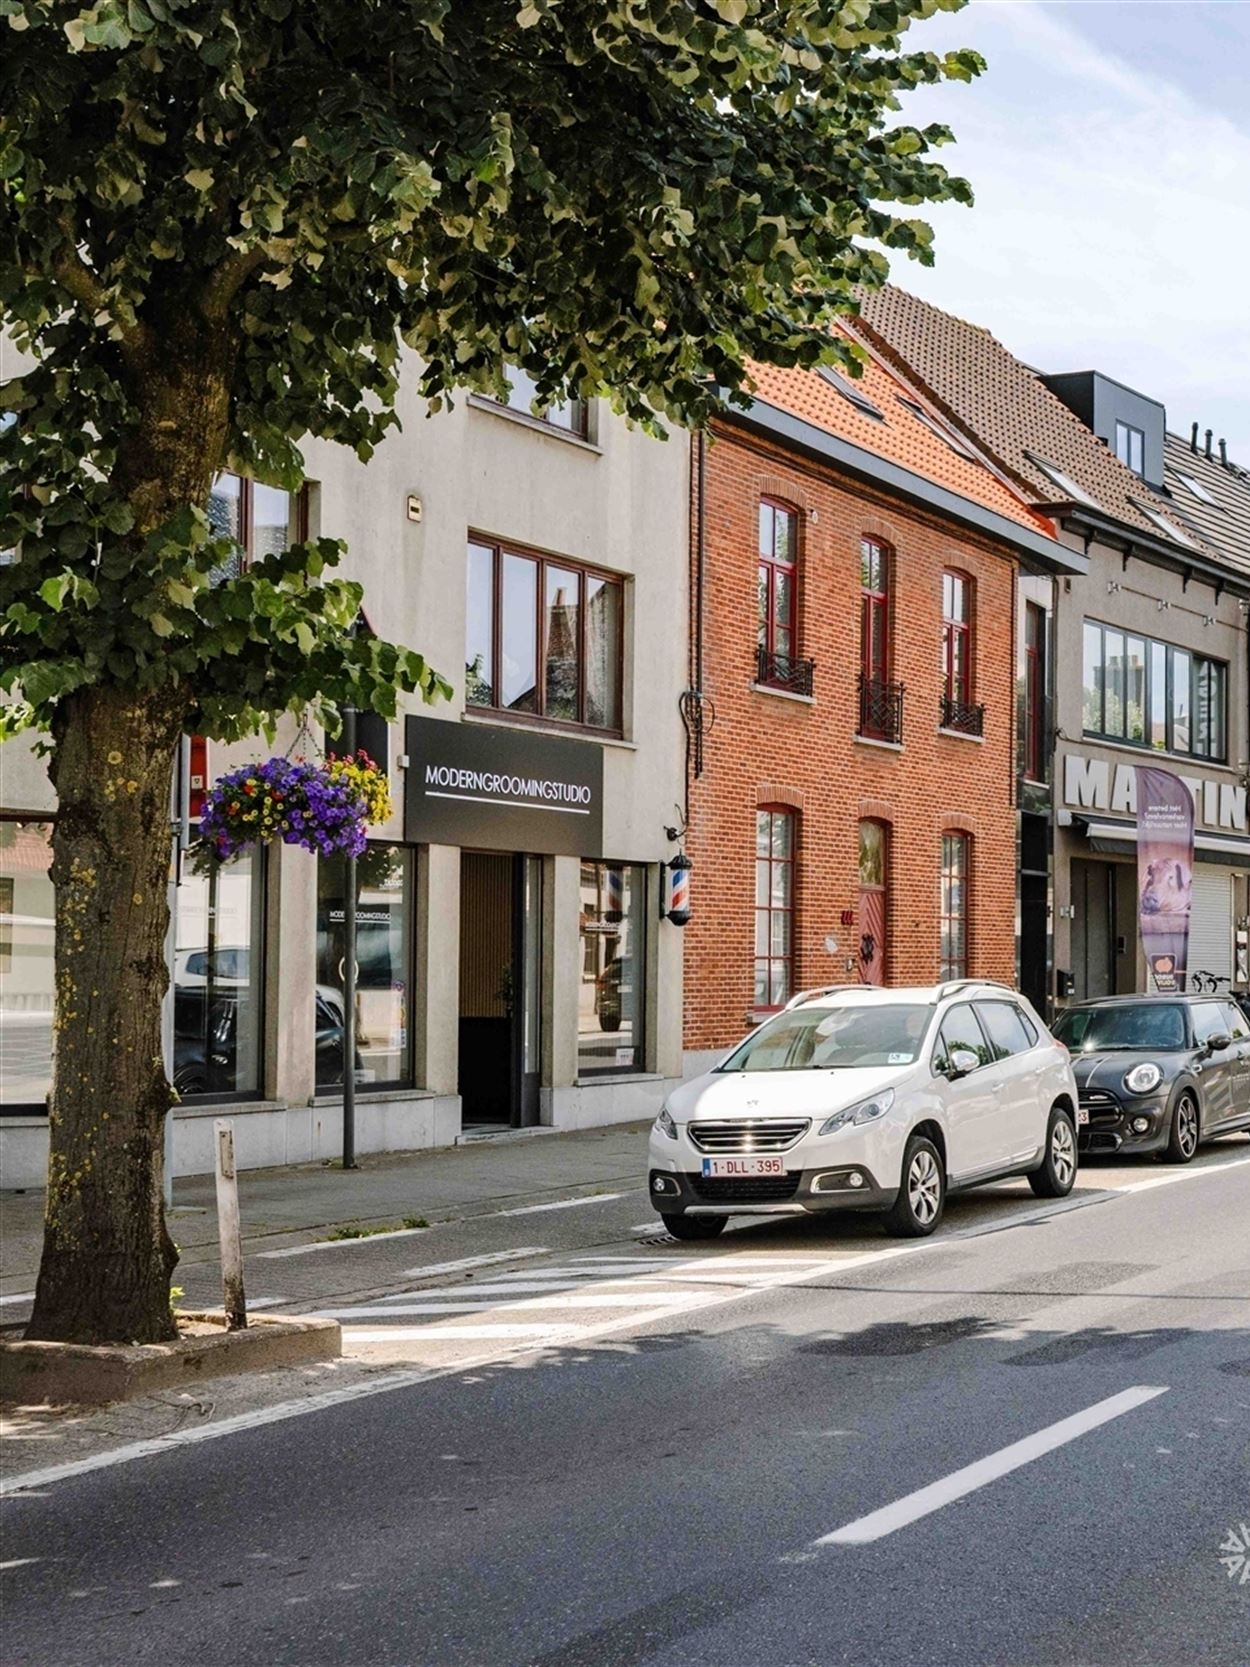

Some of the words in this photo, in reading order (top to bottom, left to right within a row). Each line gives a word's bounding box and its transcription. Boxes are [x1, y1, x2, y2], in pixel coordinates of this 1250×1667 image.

[425, 765, 591, 804] MODERNGROOMINGSTUDIO
[1064, 754, 1249, 830] MATIN
[713, 1160, 780, 1174] 1-DLL-395
